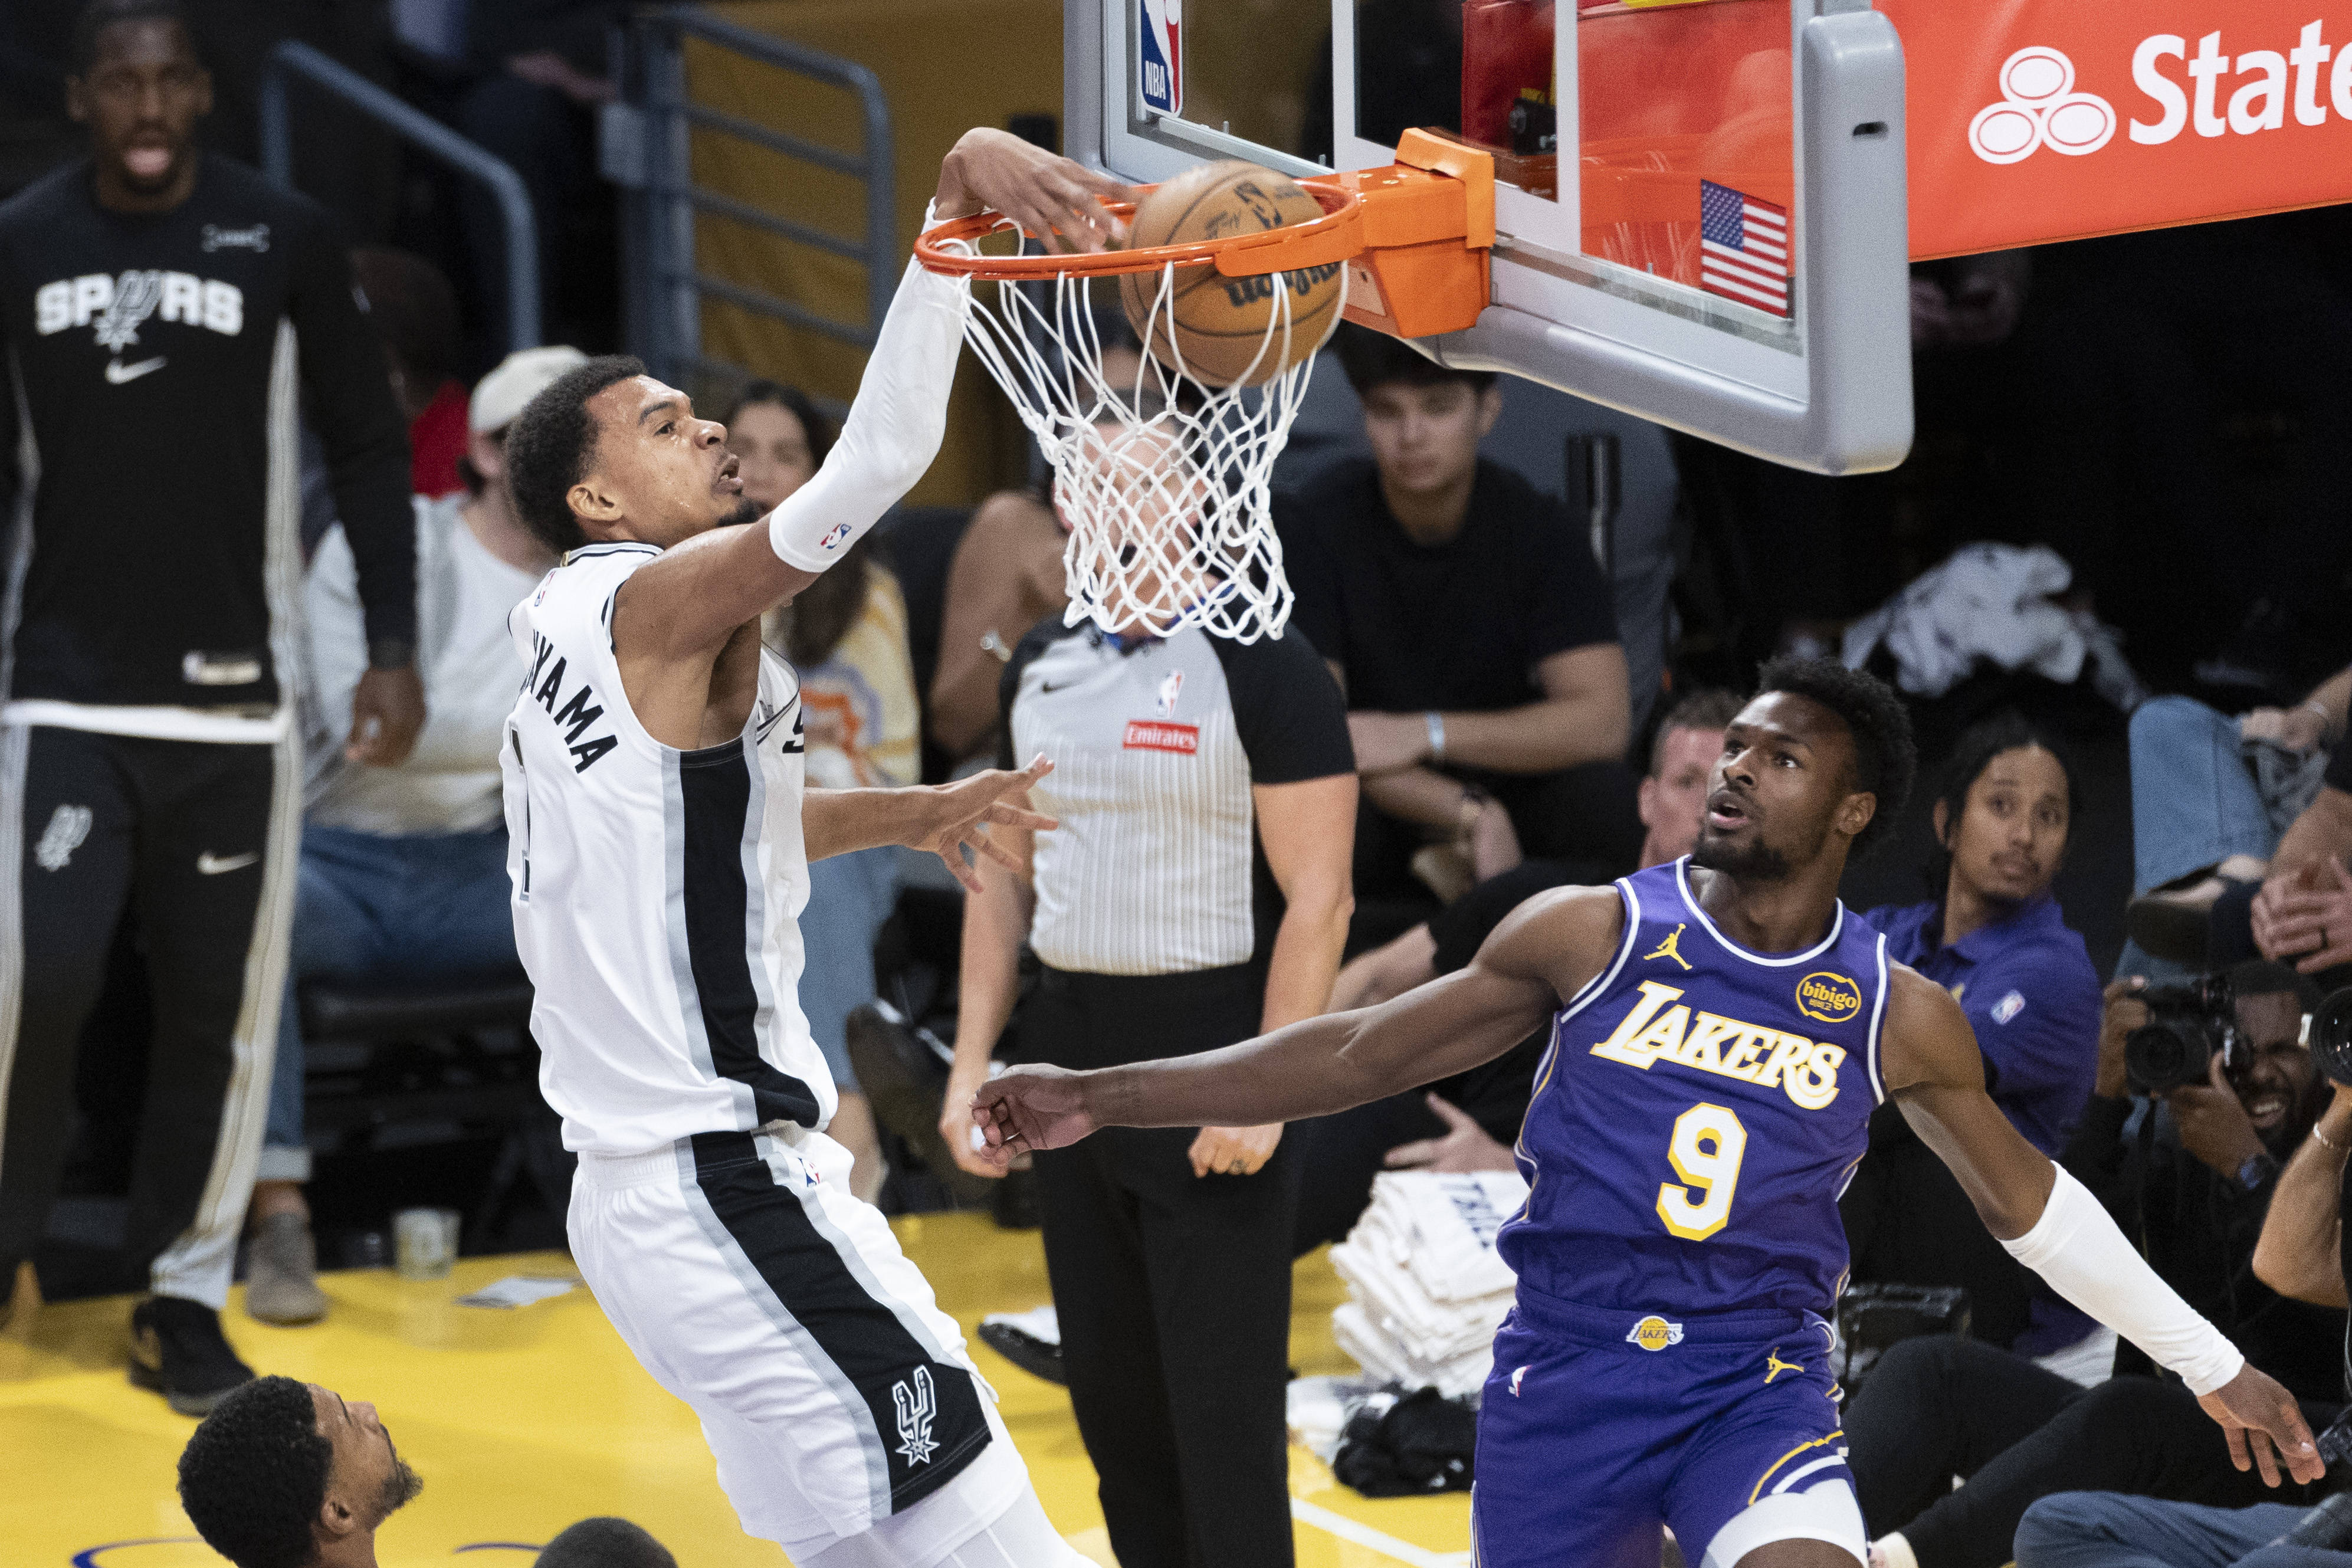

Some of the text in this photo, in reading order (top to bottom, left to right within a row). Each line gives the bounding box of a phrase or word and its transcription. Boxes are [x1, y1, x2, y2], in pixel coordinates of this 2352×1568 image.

[1144, 60, 1167, 100] NBA
[521, 629, 618, 774] YAMA
[1127, 725, 1197, 749] Emirates
[1803, 980, 1857, 1011] bibigo
[1589, 979, 1847, 1110] LAKERS
[1655, 1101, 1748, 1242] 9
